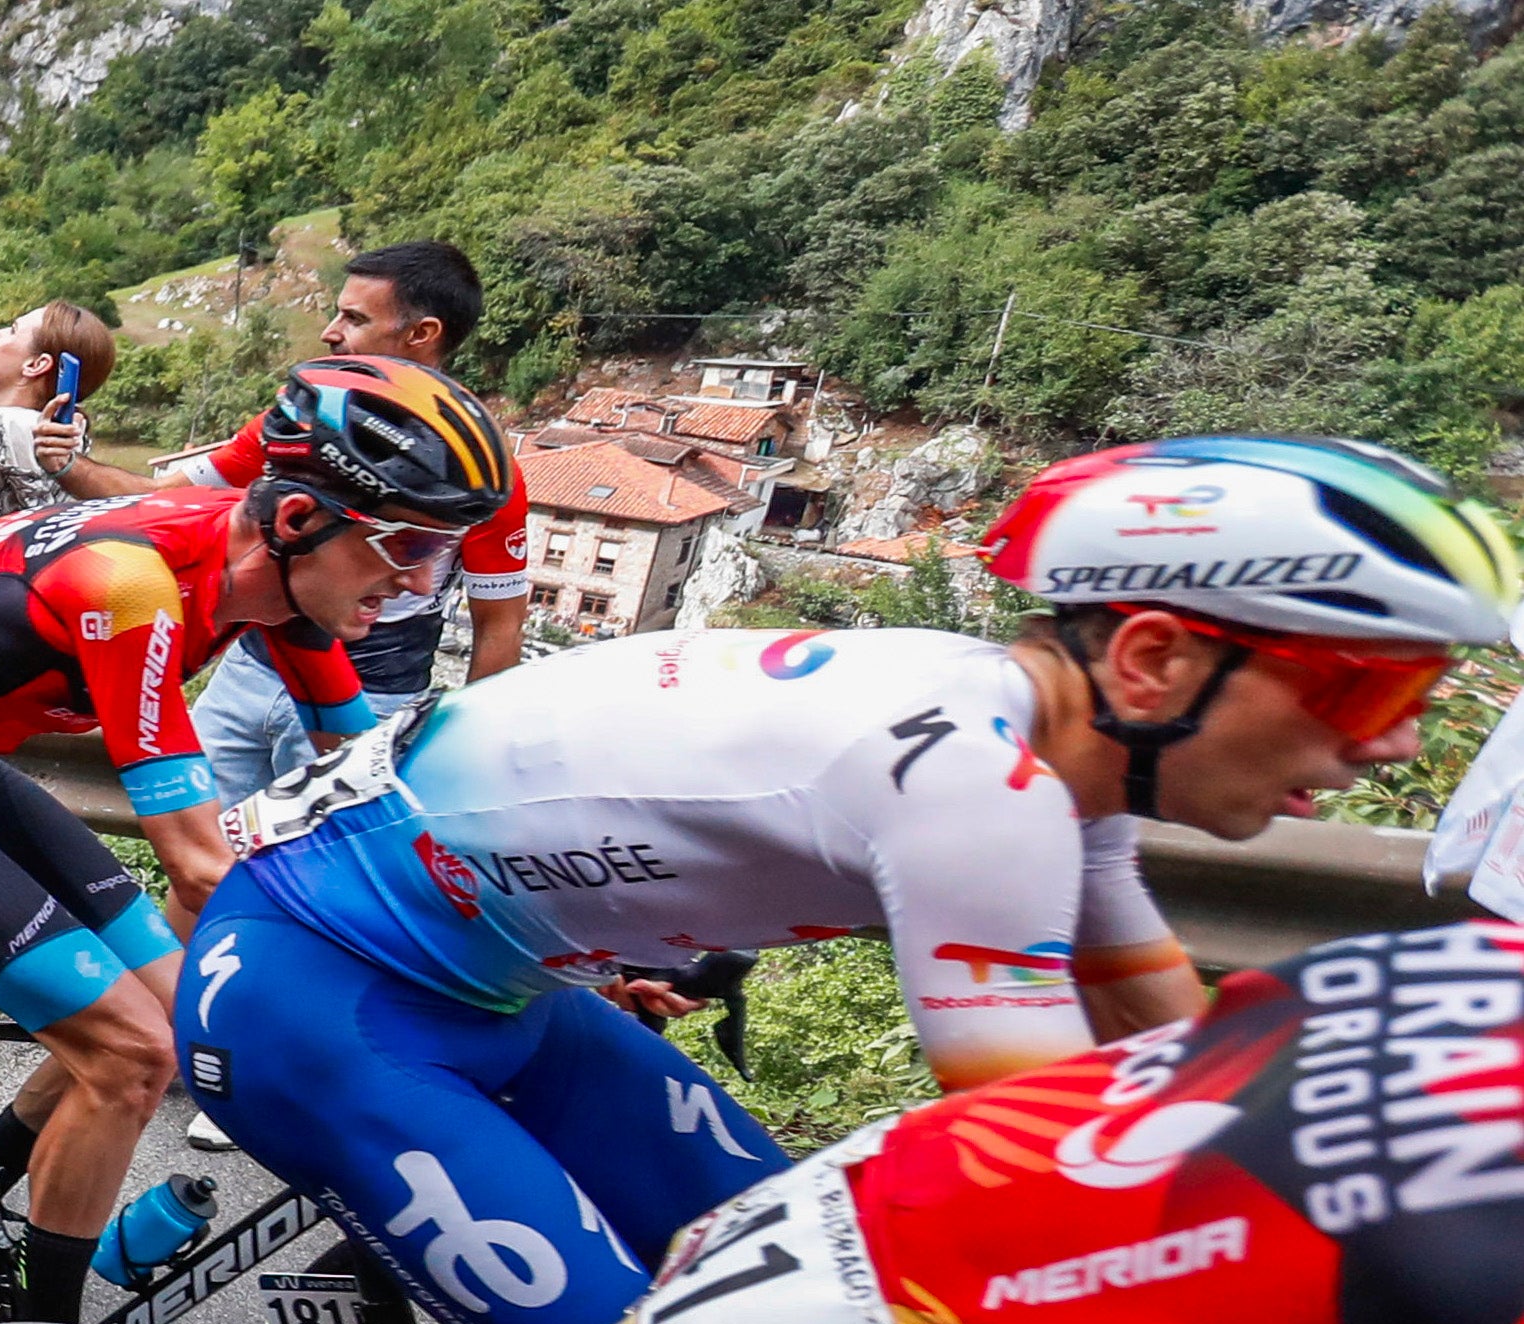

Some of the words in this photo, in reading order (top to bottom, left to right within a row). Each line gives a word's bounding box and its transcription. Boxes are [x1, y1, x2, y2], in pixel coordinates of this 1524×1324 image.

[319, 442, 398, 496] RUDY
[1044, 553, 1362, 594] SPECIALIZED
[137, 608, 176, 755] MERIDA
[476, 835, 678, 897] VENDÉE
[982, 1217, 1248, 1309] MERIDA
